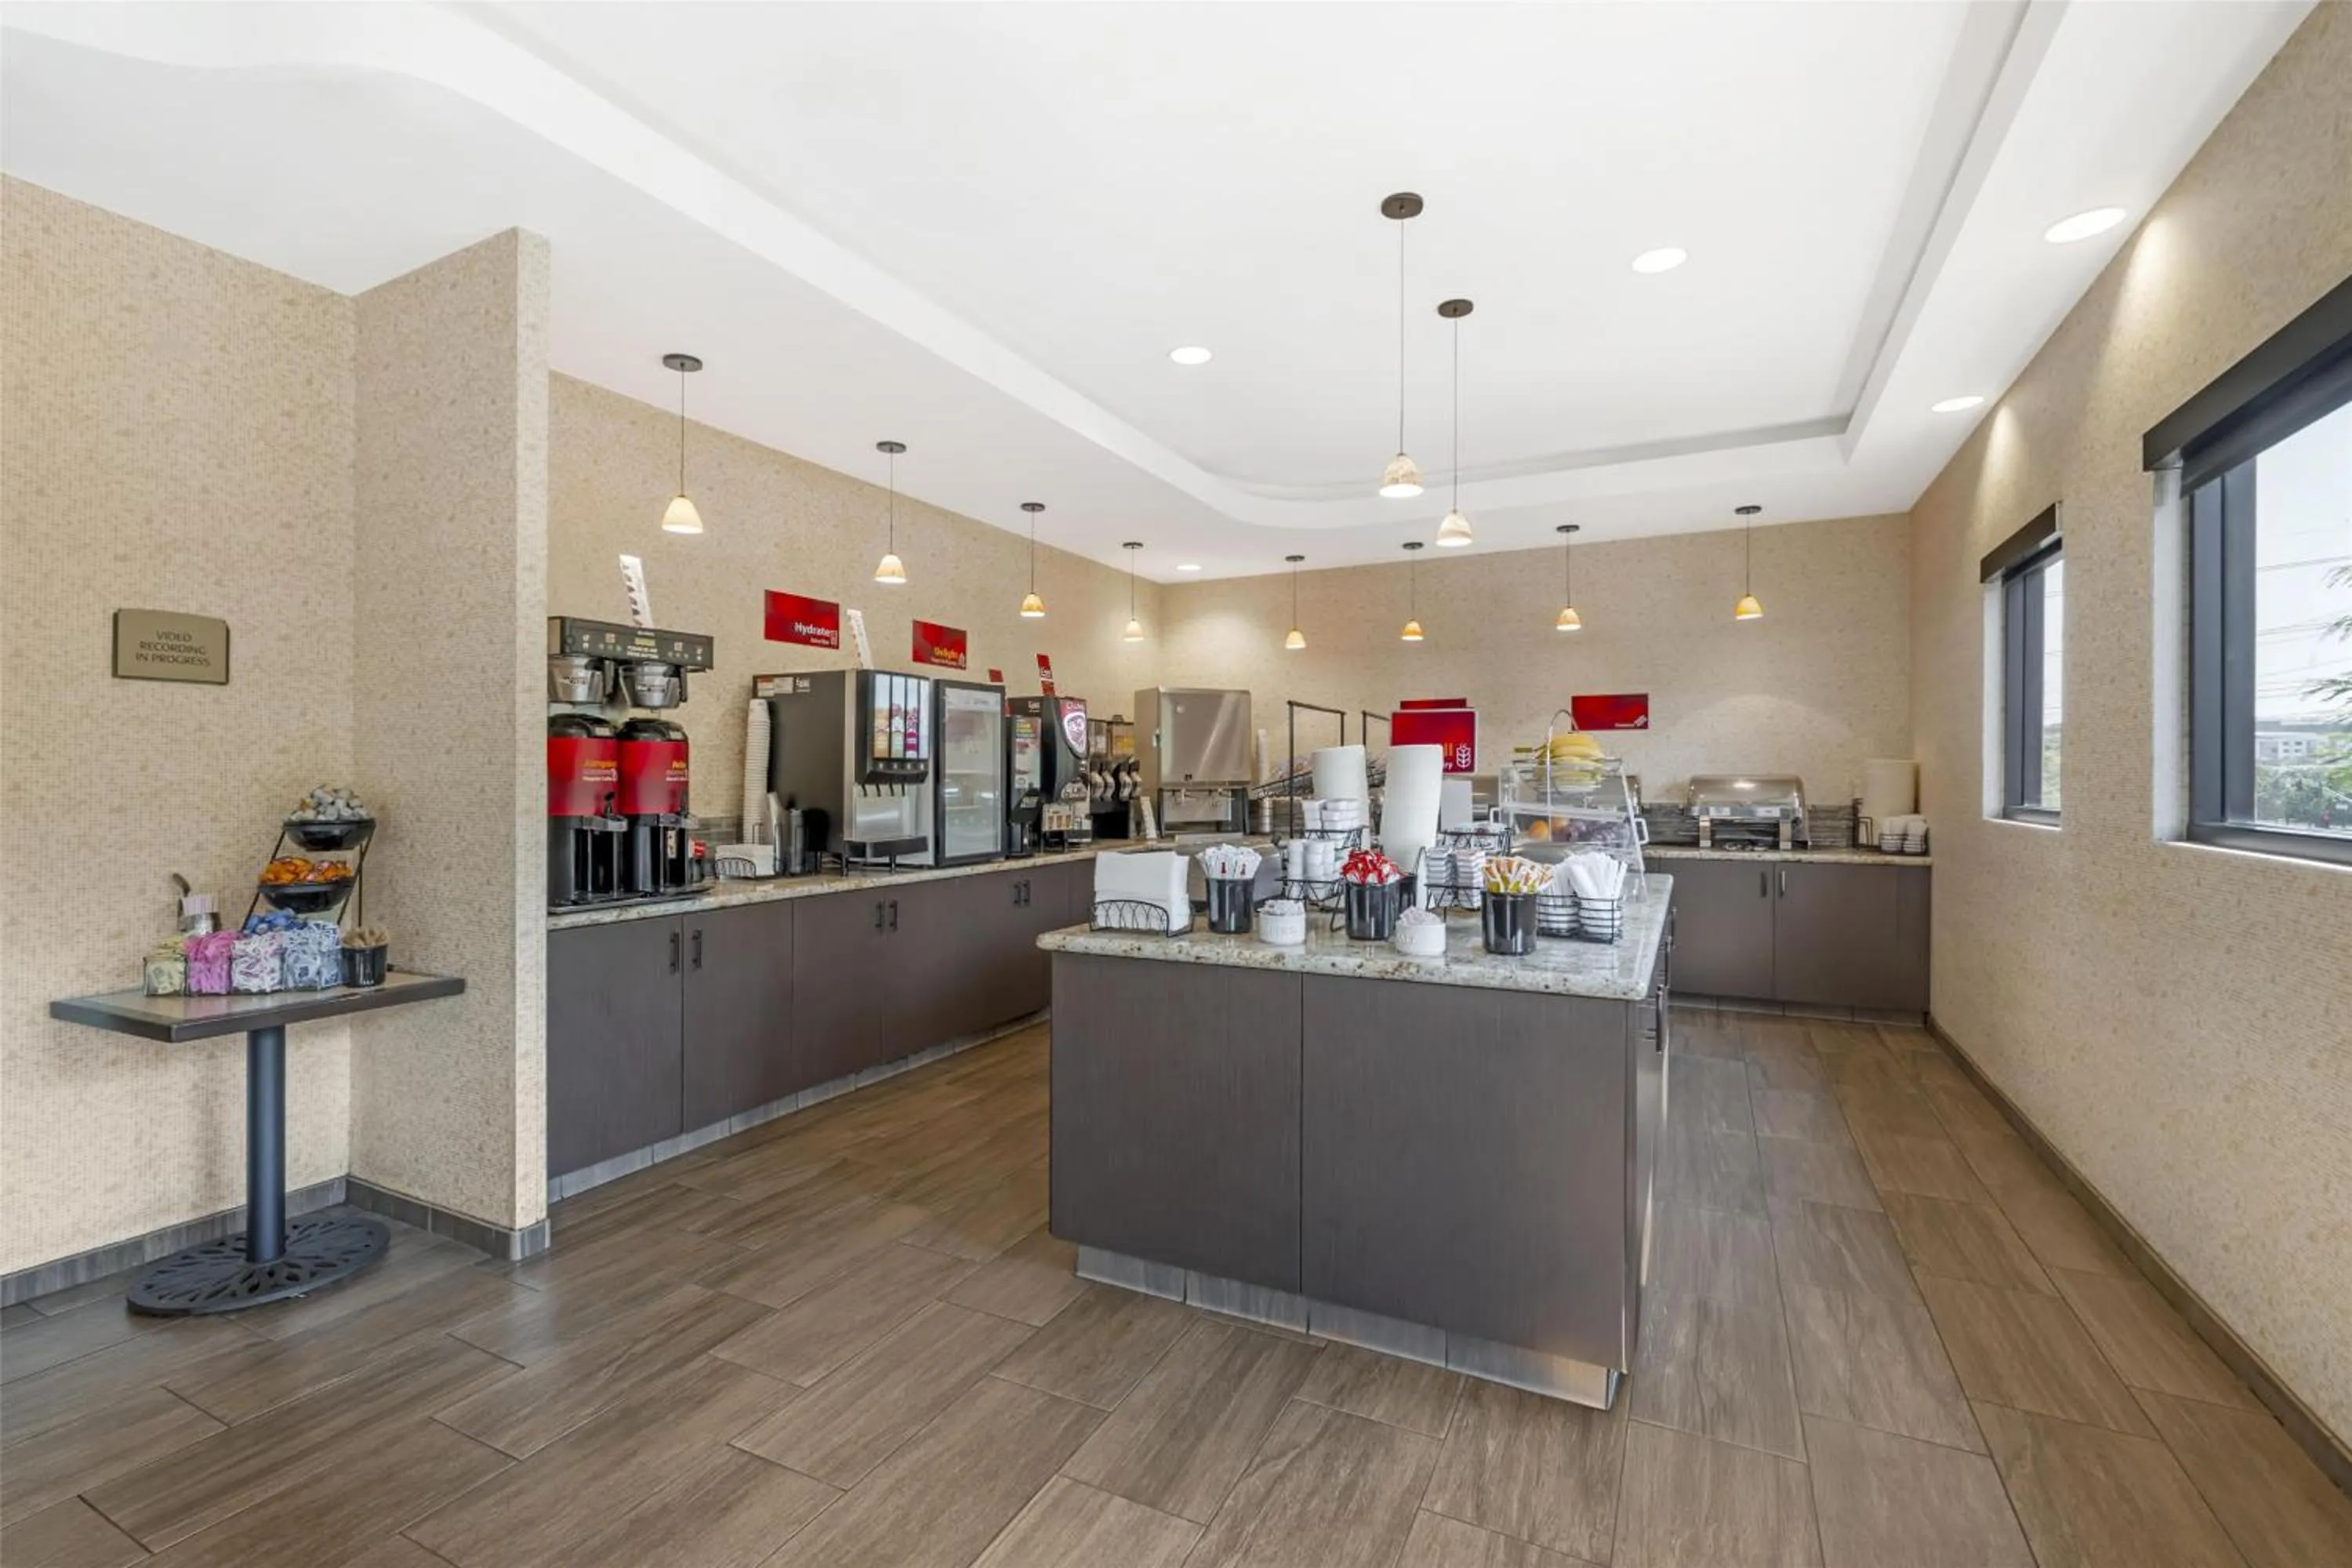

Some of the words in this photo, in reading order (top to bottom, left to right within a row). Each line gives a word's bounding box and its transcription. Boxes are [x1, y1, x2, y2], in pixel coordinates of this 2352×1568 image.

[156, 630, 193, 642] VIDEO
[793, 621, 829, 637] Hydrate
[140, 641, 206, 655] RECORDING
[136, 652, 148, 662] IN
[152, 653, 211, 667] PROGRESS
